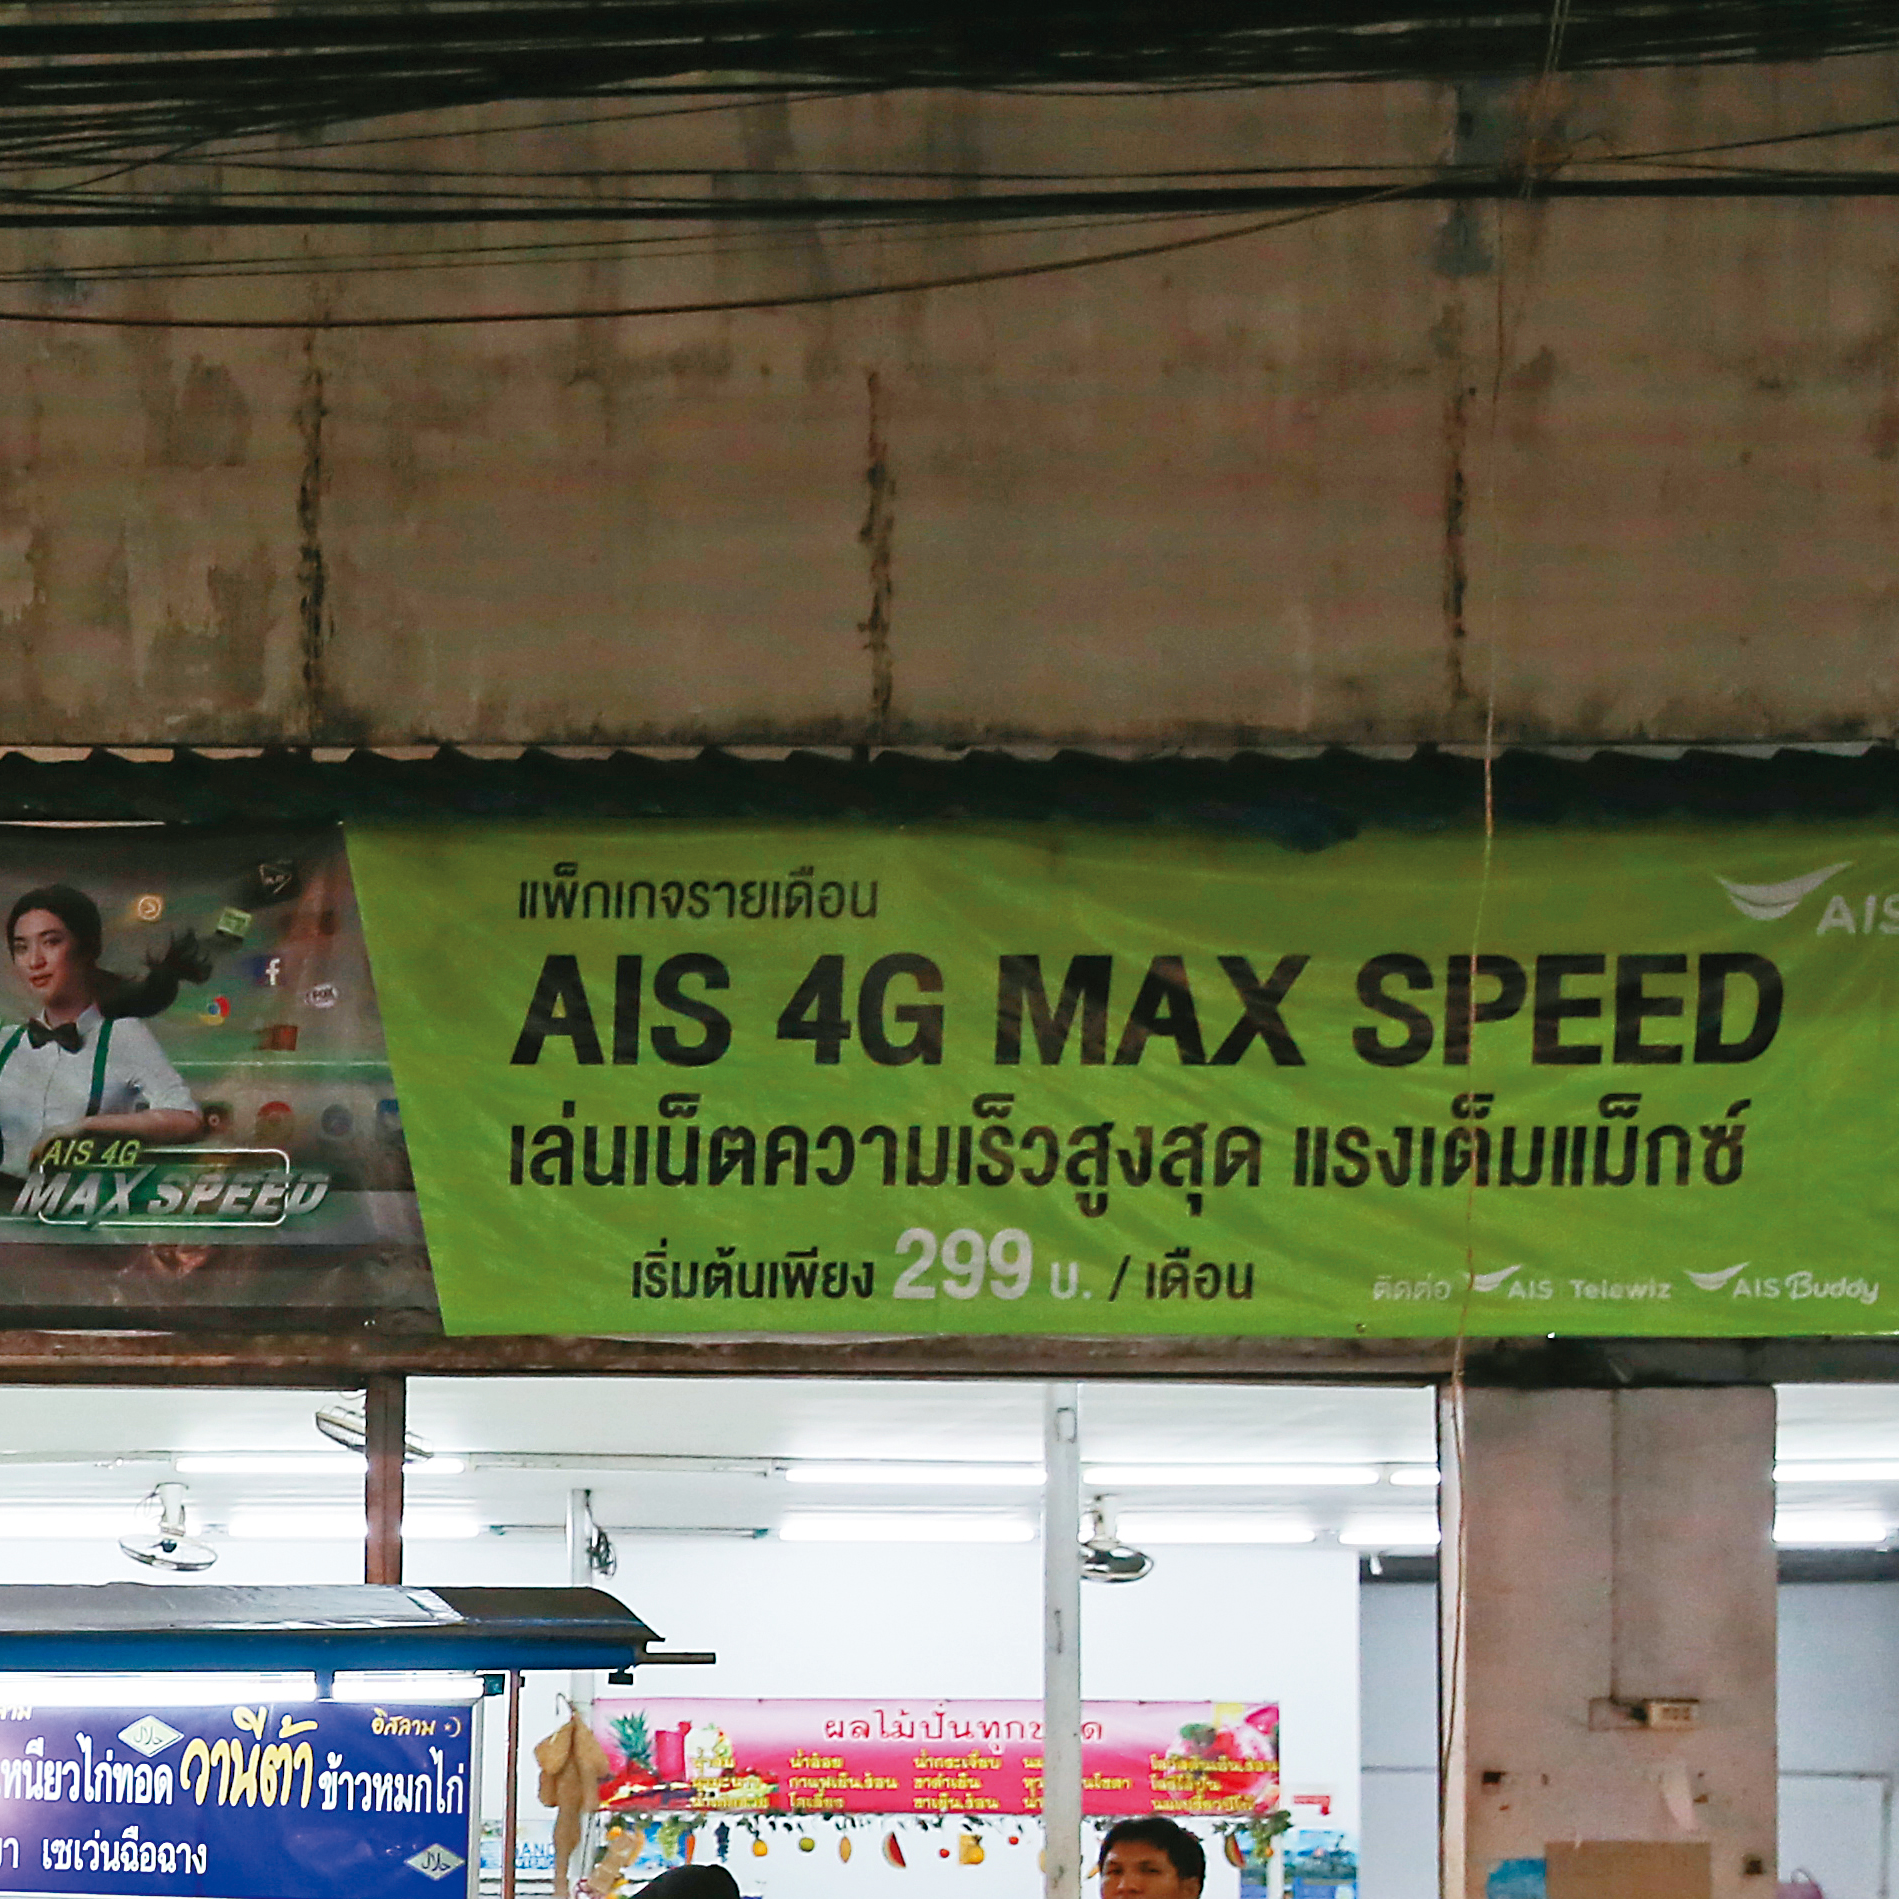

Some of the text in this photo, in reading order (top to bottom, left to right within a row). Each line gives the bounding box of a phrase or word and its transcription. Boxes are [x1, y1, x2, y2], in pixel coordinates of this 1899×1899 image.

[519, 861, 877, 920] แพ็กเกจรายเดือน
[510, 951, 1785, 1069] AIS 4G MAX SPEED
[42, 1139, 141, 1166] AIS 4G
[509, 1092, 1750, 1218] เล่นเน็ตความเร็วสูงสุด แรงเต็มแม็กซ์
[11, 1166, 330, 1222] MAX SPEED
[630, 1237, 873, 1301] เริ่มต้นเพียง
[894, 1227, 1033, 1302] 299
[1144, 1246, 1255, 1301] เดือน
[1507, 1280, 1553, 1300] AIS
[1569, 1280, 1672, 1300] Telewiz
[1732, 1278, 1780, 1299] AIS
[1785, 1271, 1879, 1304] Buddy
[372, 1707, 437, 1737] อิสลาม
[180, 1706, 318, 1808] วานีต้า
[318, 1746, 464, 1815] ข้าวหมกไก่
